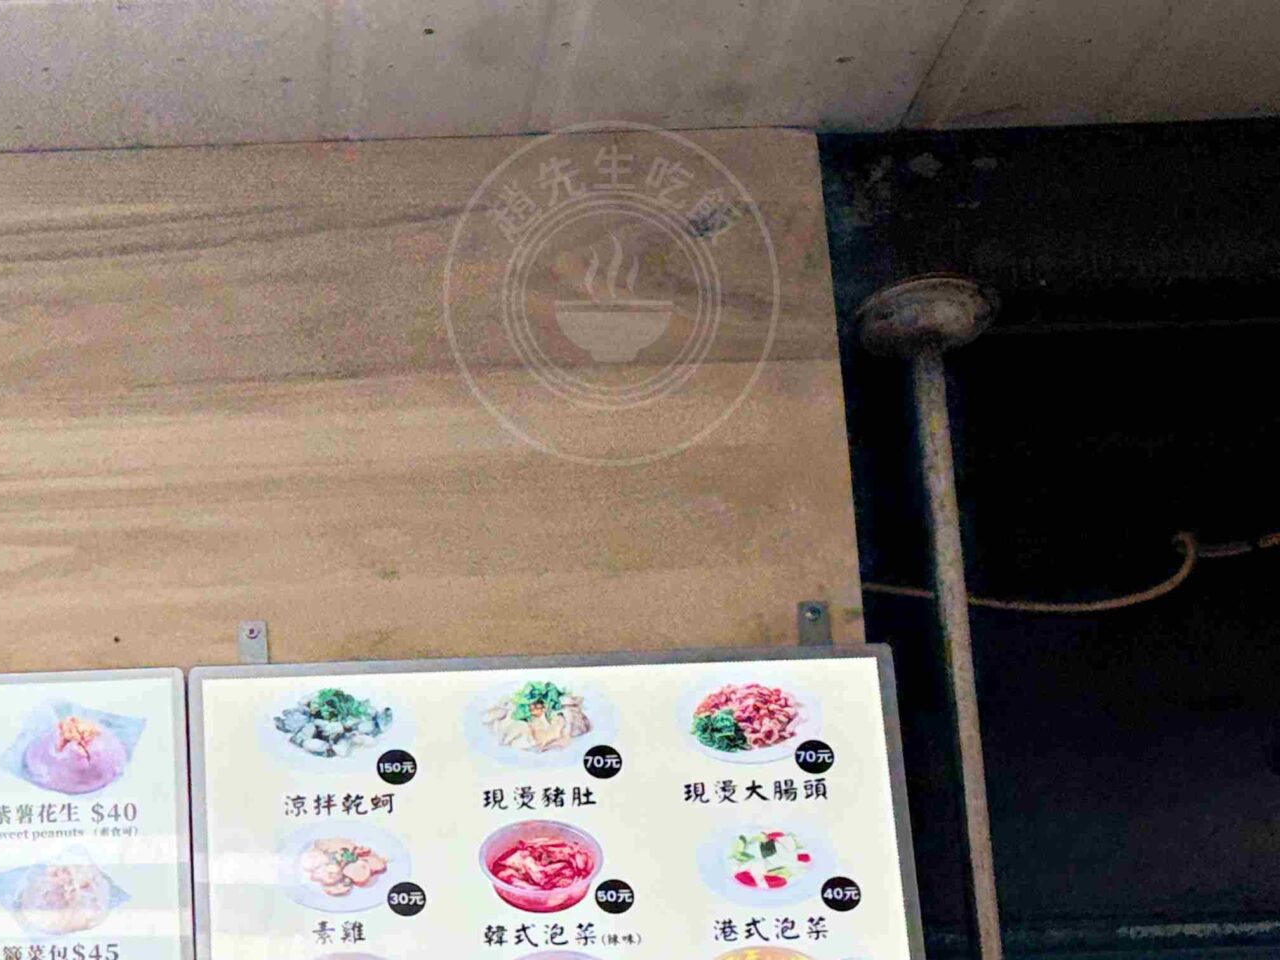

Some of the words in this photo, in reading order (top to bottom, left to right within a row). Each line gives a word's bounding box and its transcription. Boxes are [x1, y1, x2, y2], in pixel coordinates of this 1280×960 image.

[583, 755, 621, 769] 70元
[796, 750, 833, 764] 70元
[379, 761, 416, 775] 150元
[482, 785, 597, 810] 現燙豬肚
[683, 778, 829, 804] 現燙大腸頭
[91, 801, 137, 823] $40
[284, 793, 396, 817] 涼拌乾蚵
[33, 828, 84, 841] peanuts
[389, 892, 425, 905] 30元
[596, 889, 633, 903] 50元
[823, 887, 860, 900] 40元
[713, 916, 829, 941] 港式泡菜
